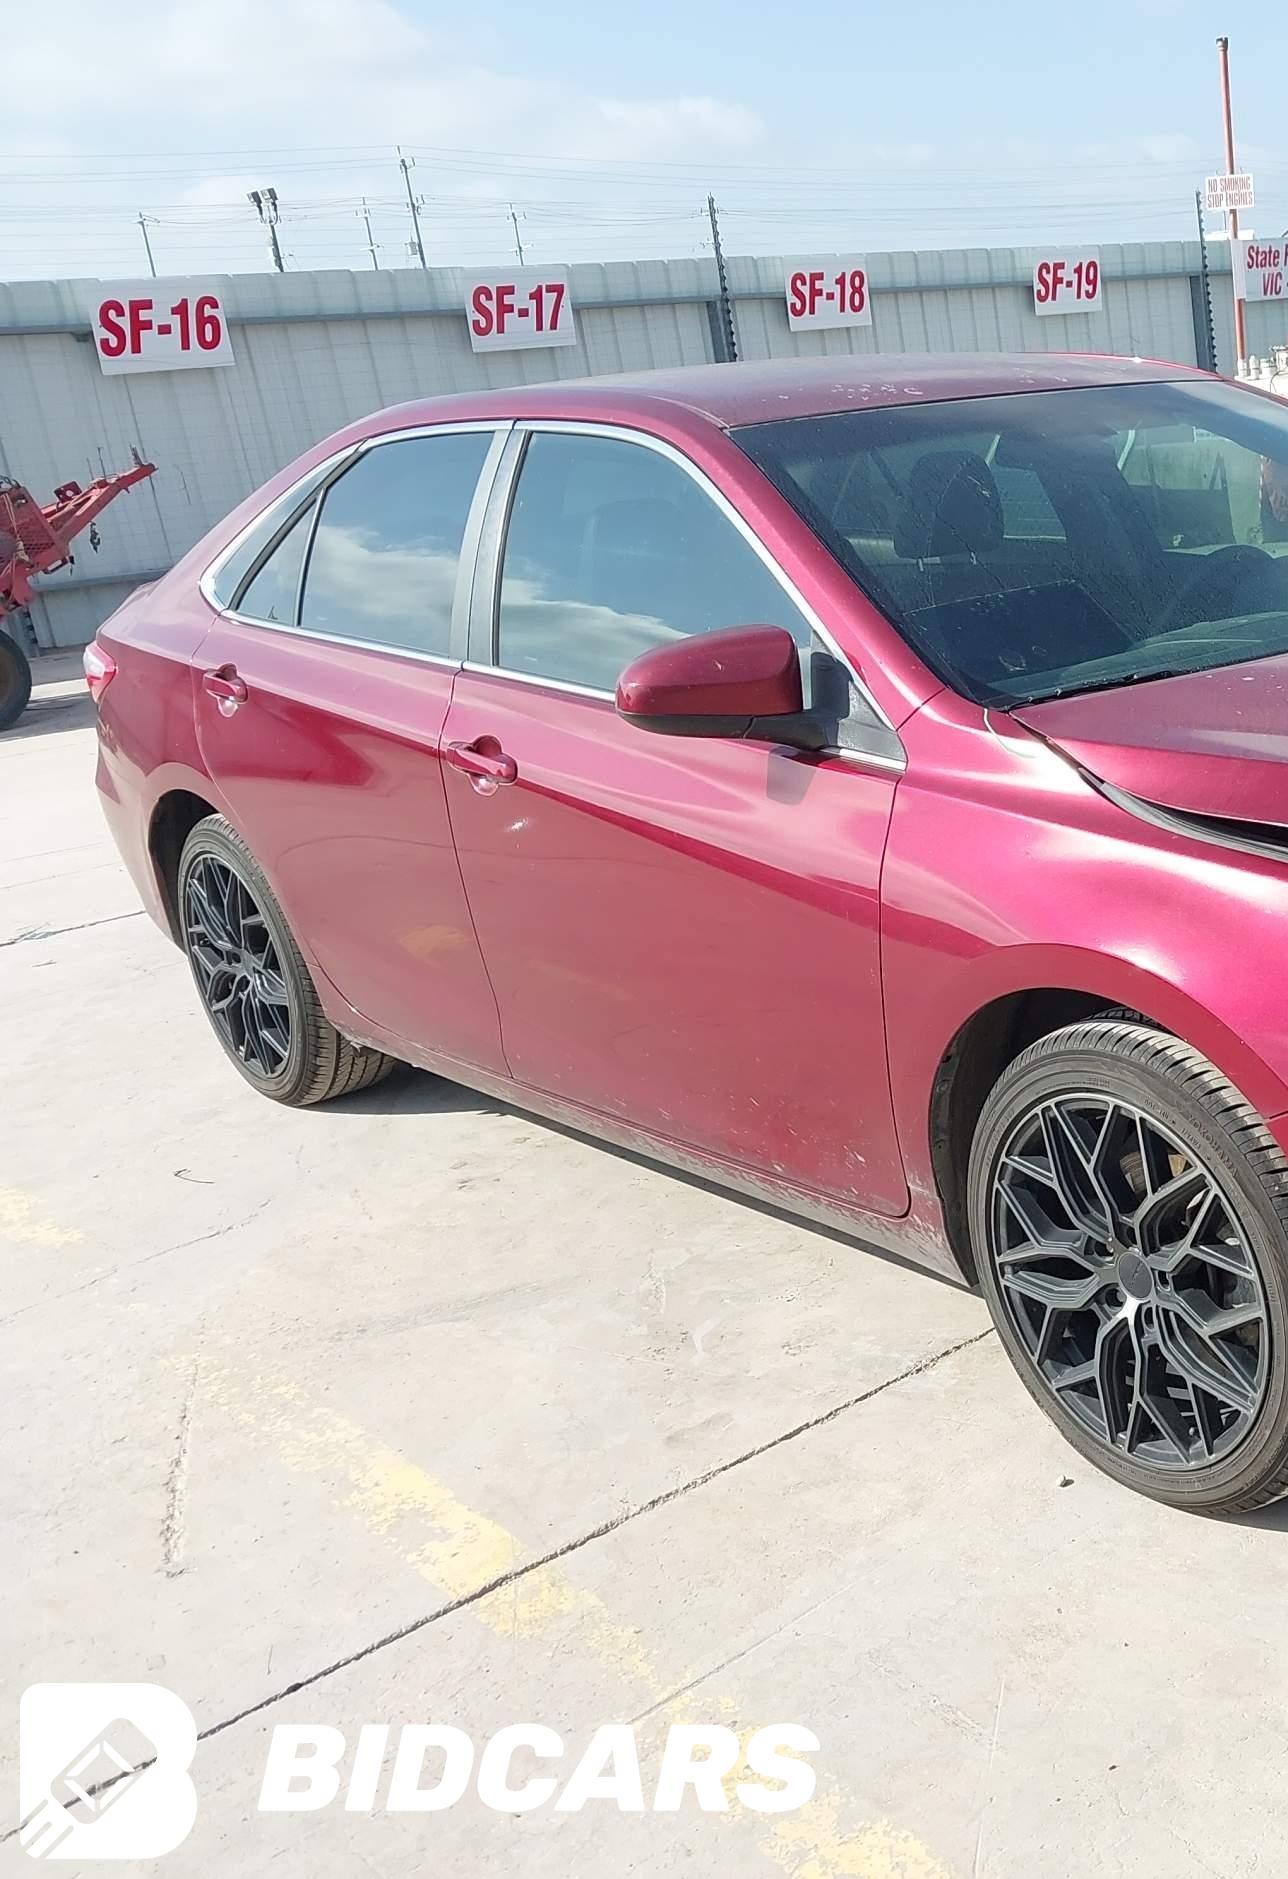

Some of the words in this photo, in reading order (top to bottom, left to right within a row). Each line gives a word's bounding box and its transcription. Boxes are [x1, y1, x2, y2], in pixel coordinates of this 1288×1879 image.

[1207, 194, 1224, 208] STOP
[1225, 191, 1253, 207] ENGINES
[1208, 178, 1218, 193] NO
[1220, 175, 1251, 192] SMOKING
[1247, 244, 1280, 269] State
[790, 270, 865, 317] SF-18
[1036, 260, 1098, 303] SF-19
[1263, 271, 1283, 297] VIC
[98, 295, 222, 357] SF-16
[472, 283, 565, 337] SF-17
